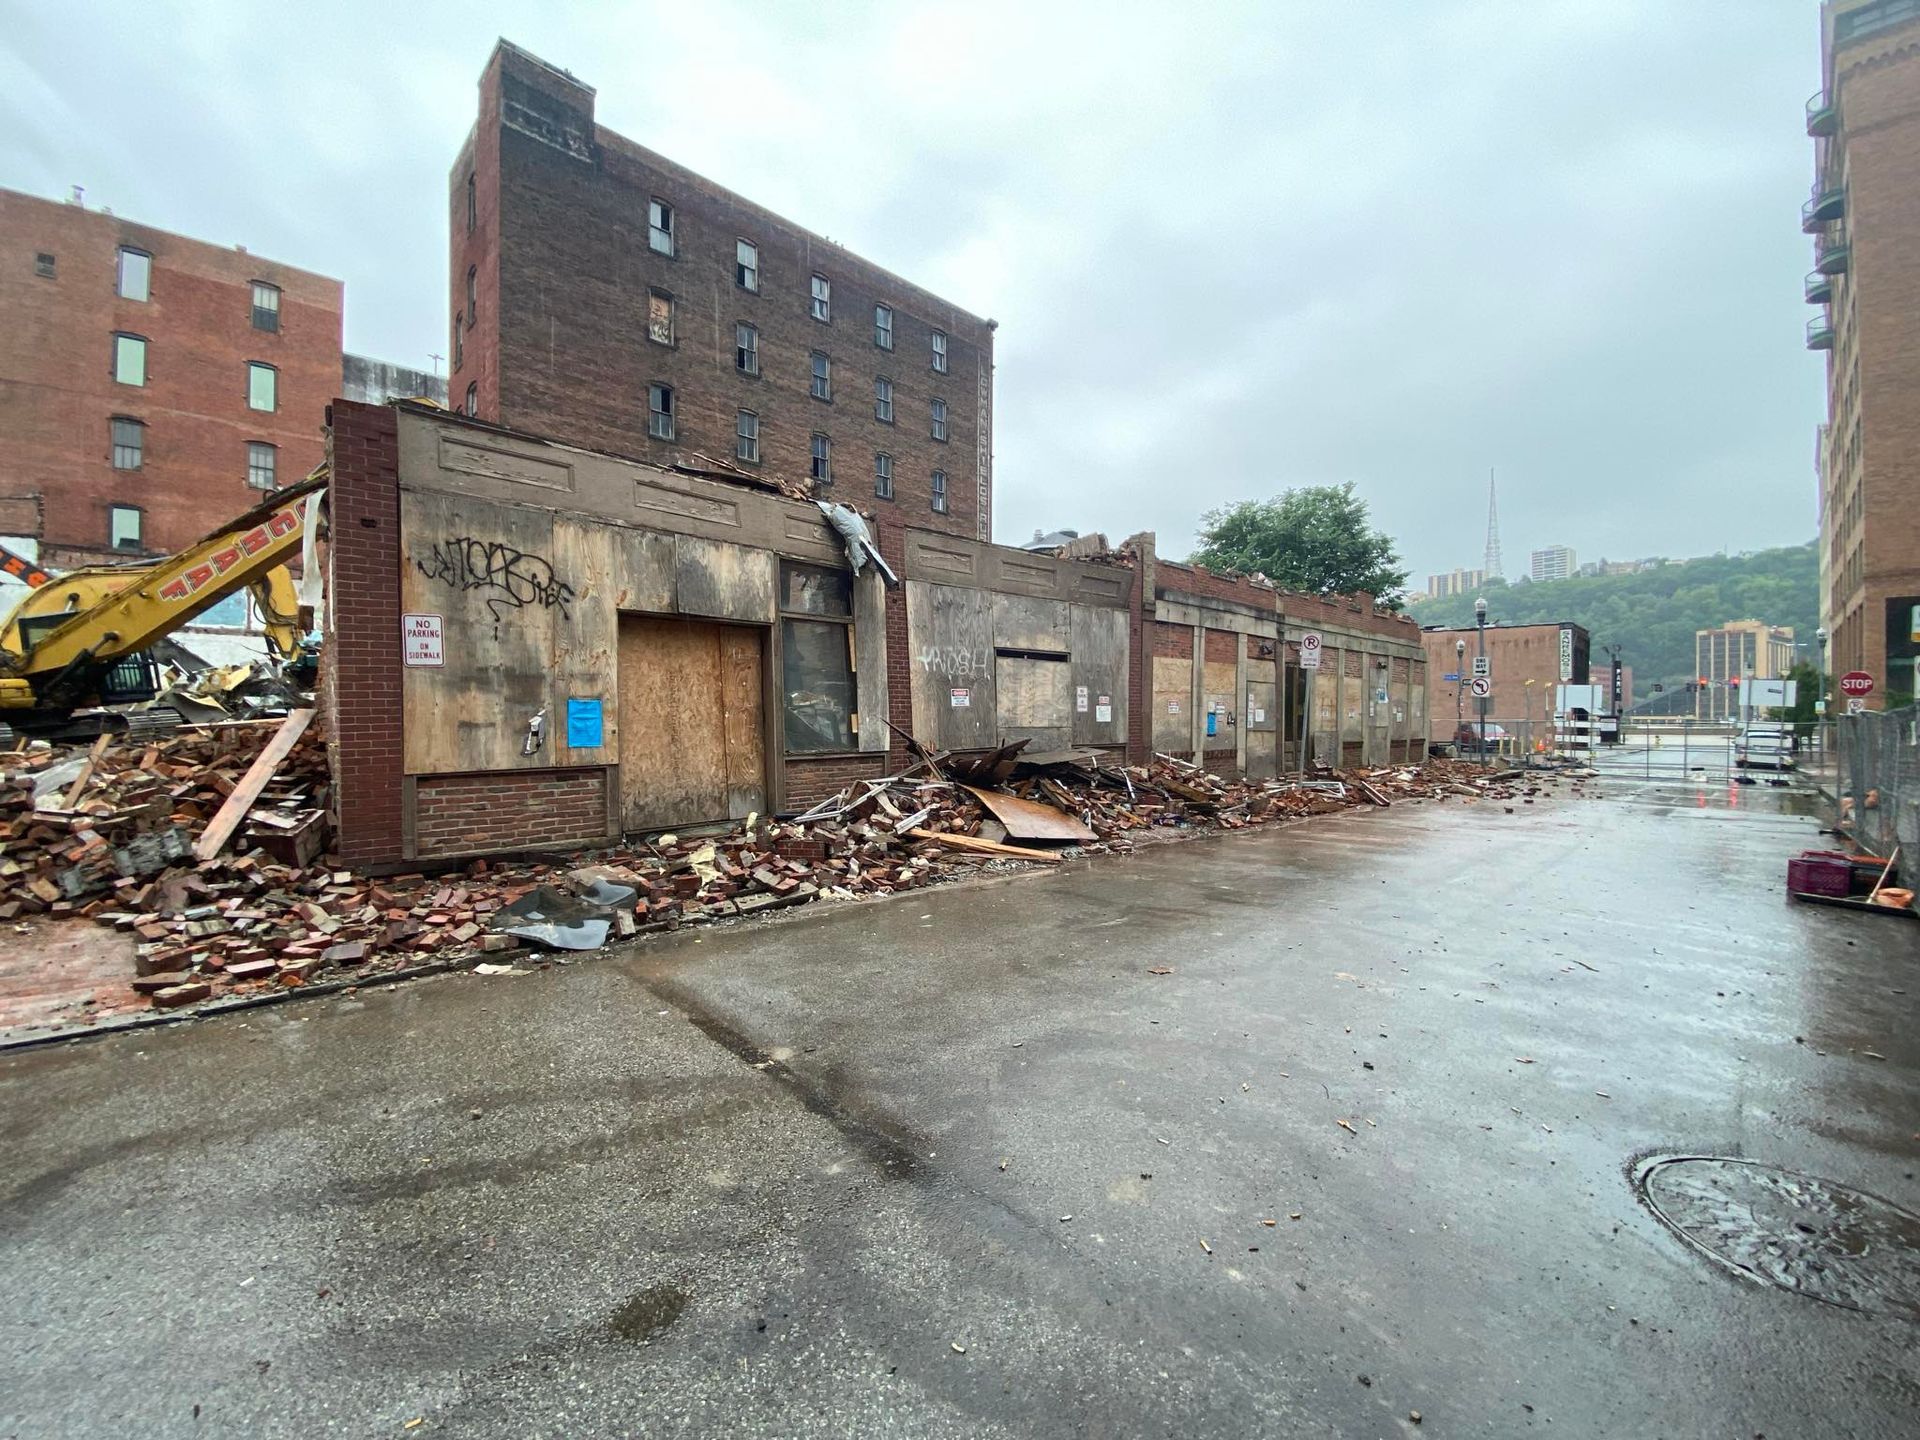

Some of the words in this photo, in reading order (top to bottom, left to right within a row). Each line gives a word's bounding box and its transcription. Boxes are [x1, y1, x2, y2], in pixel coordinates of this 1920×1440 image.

[415, 620, 431, 628] NO
[407, 629, 440, 638] PARKING
[419, 642, 429, 650] ON
[408, 651, 440, 659] SIDEWALK
[1842, 679, 1873, 689] STOP
